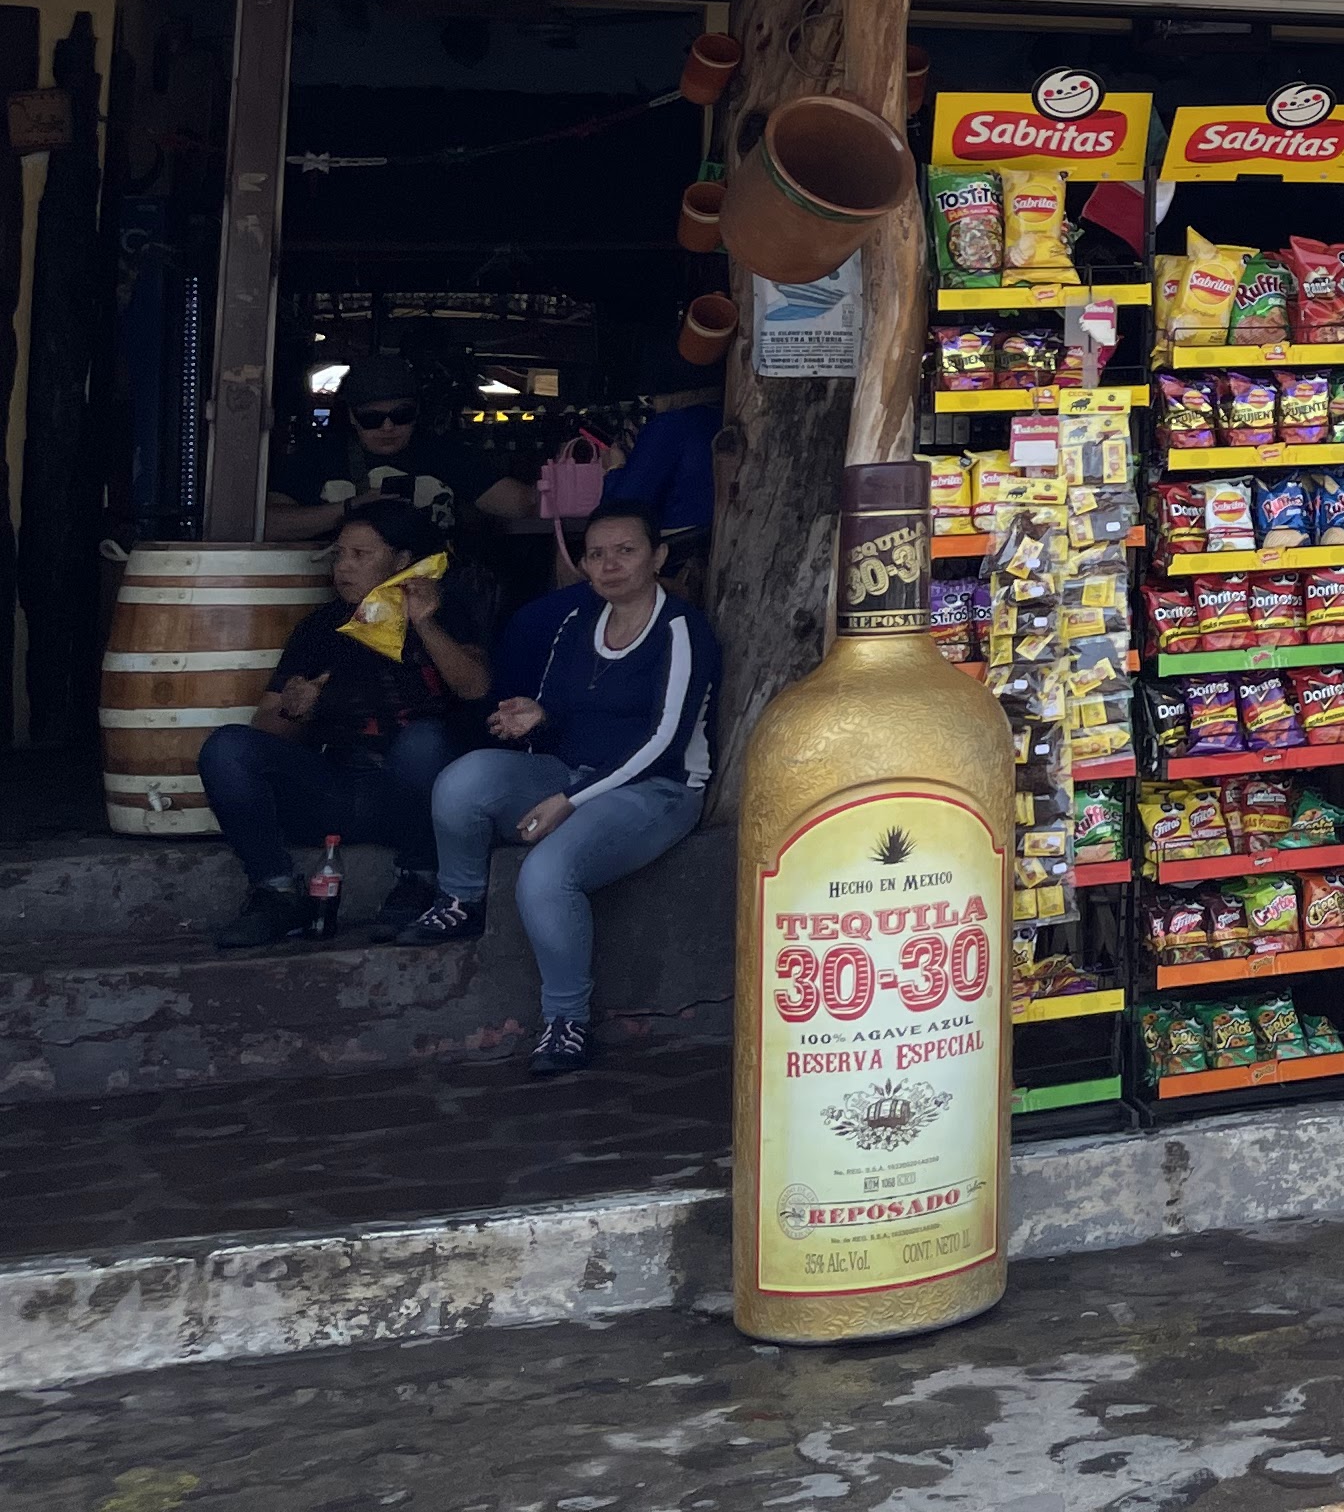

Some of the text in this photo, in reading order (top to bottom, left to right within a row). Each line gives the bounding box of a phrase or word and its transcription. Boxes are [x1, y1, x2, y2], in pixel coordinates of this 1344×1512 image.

[965, 115, 1114, 152] Sabritas
[1198, 125, 1339, 156] Sabritas
[1234, 273, 1289, 309] Ruffle
[931, 475, 963, 487] abritas
[1199, 590, 1247, 608] Doritos
[848, 614, 927, 628] REPOSAD
[1187, 682, 1229, 700] Doritos
[1153, 817, 1180, 839] Fritos
[1189, 806, 1216, 826] Fritos
[829, 871, 953, 898] HECHO EN MEXICO
[775, 894, 988, 940] TEQUILA
[774, 924, 990, 1023] 30-30
[800, 1014, 974, 1045] 100% AGAVE AZUL
[786, 1029, 984, 1078] RESERVA ESPECIAL
[808, 1188, 961, 1225] REPOSADO
[936, 1233, 960, 1257] NETO
